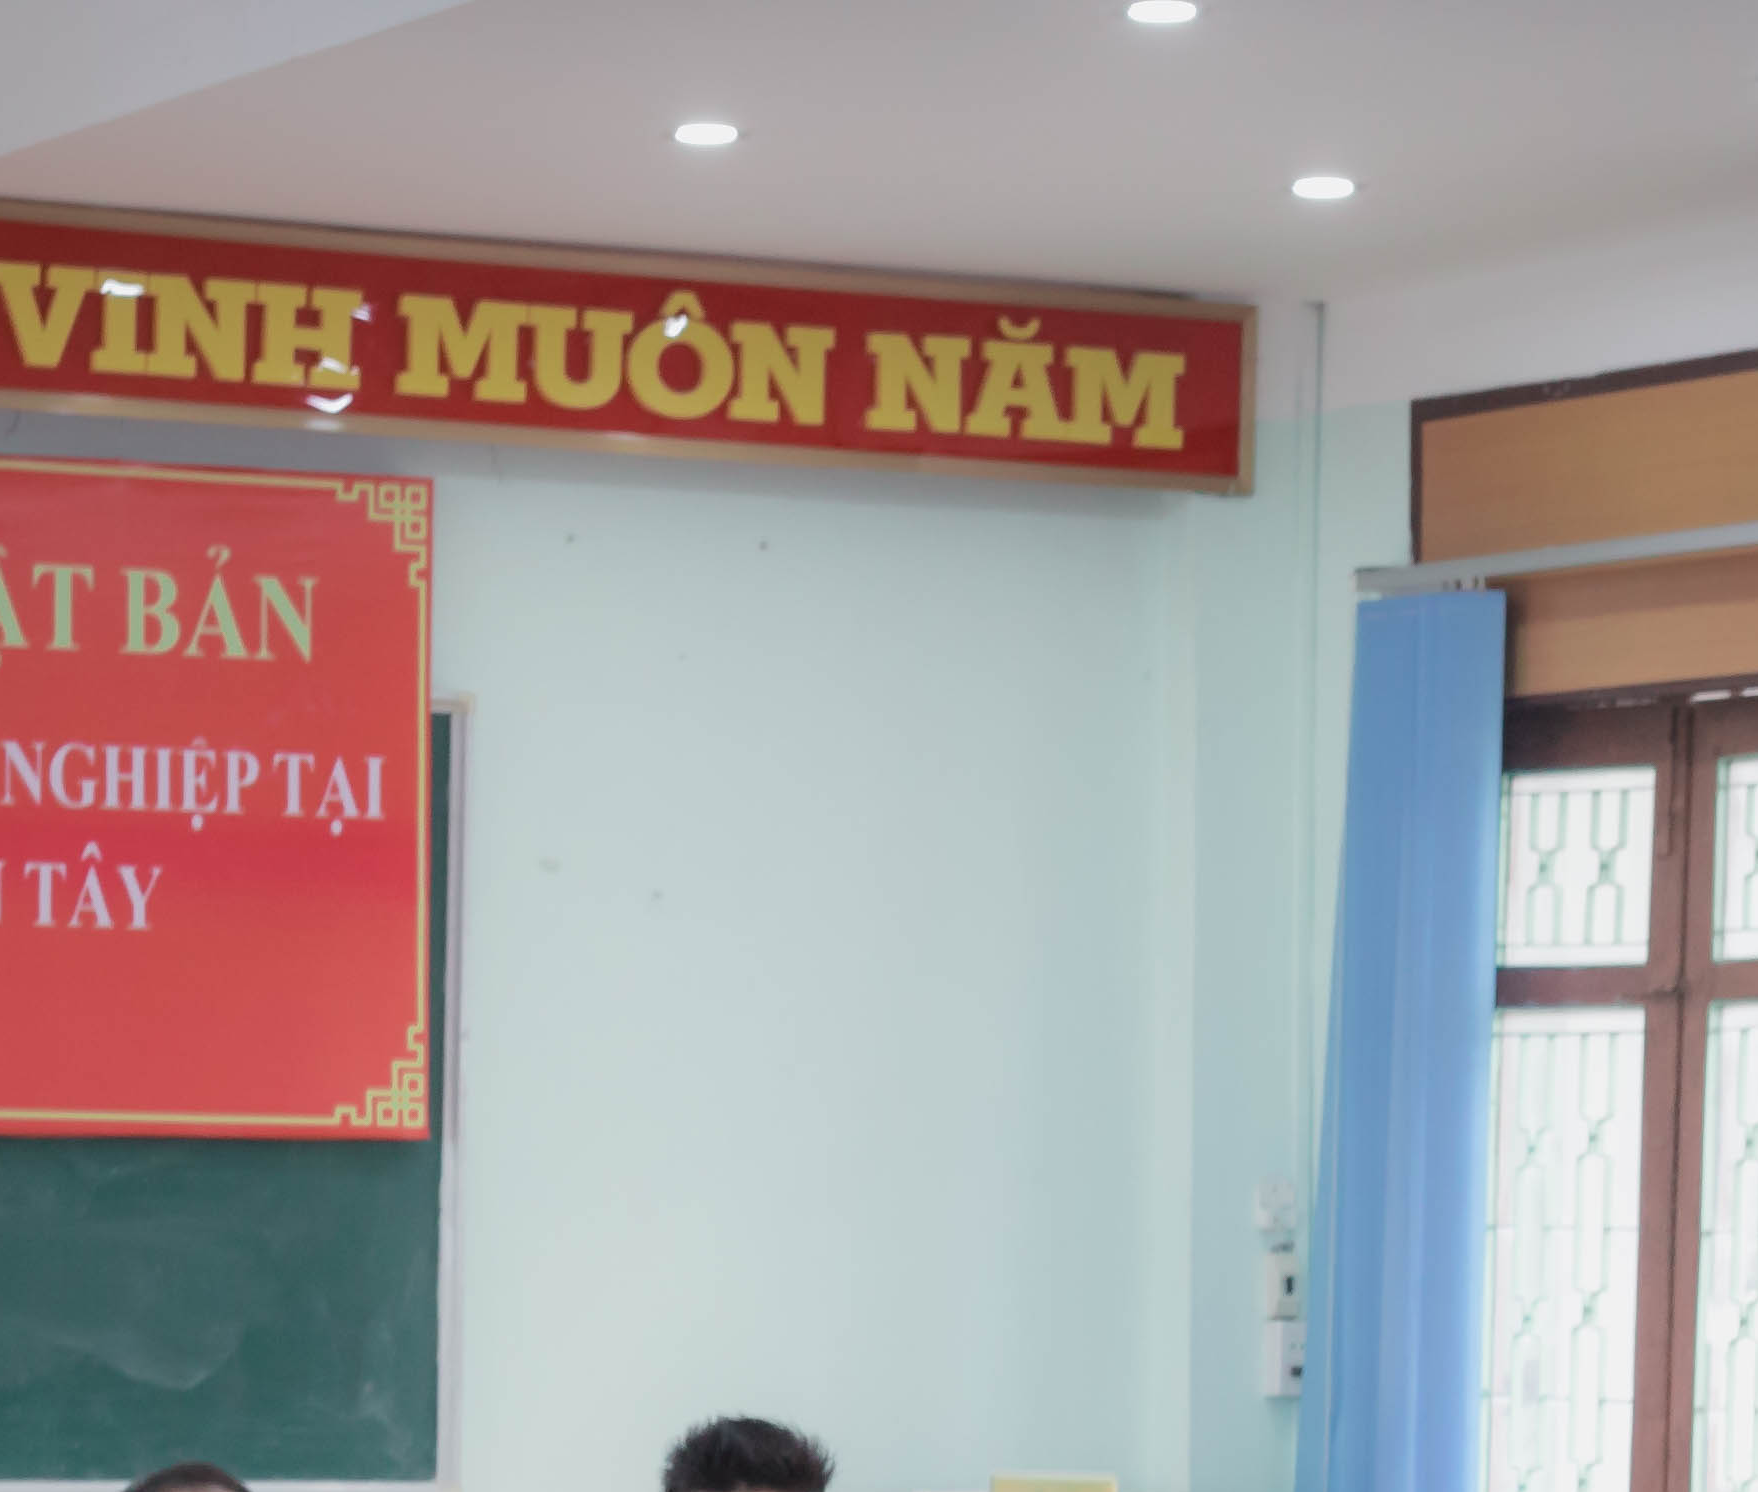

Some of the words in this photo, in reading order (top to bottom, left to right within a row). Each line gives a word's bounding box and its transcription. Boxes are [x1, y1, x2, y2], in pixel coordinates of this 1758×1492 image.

[396, 292, 834, 425] MUÔN
[865, 319, 1184, 449] NĂM
[121, 545, 317, 663] BẢN
[1, 737, 262, 832] NGHIỆP
[271, 751, 385, 837] TẠI
[23, 840, 163, 932] TÂY
